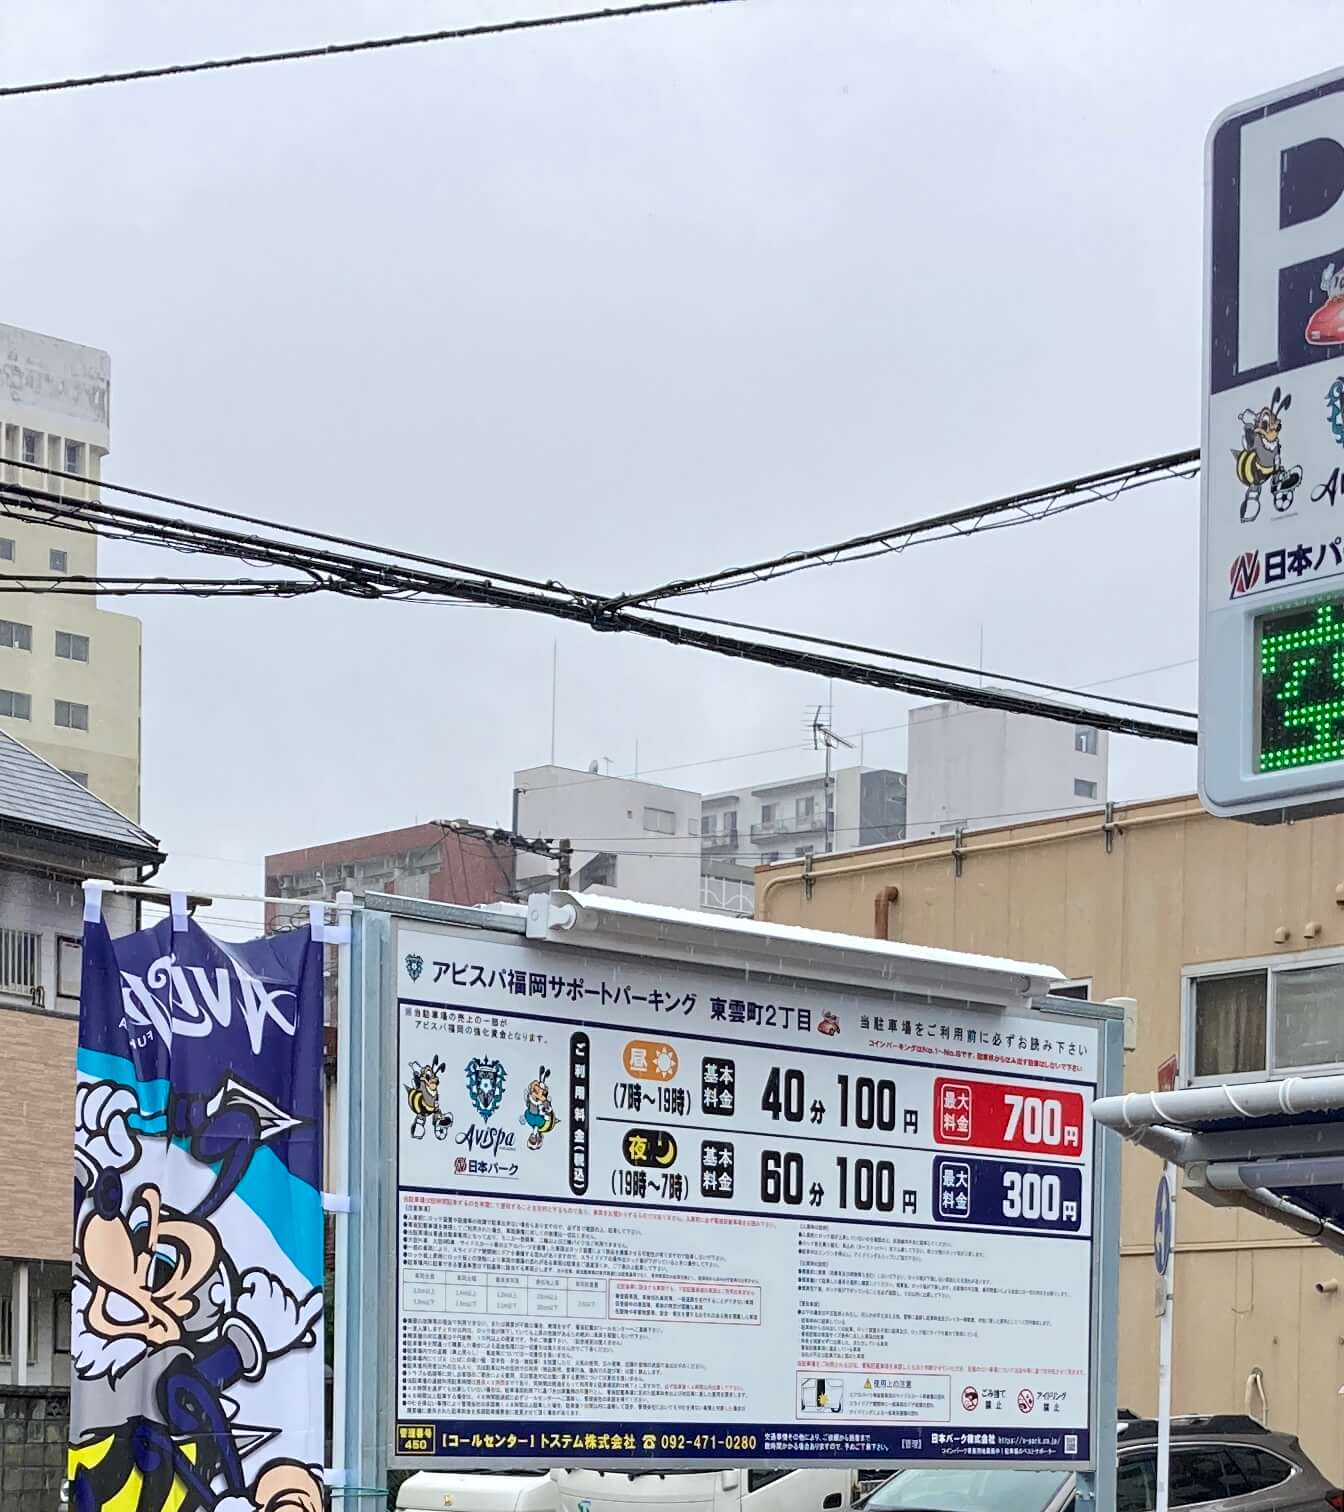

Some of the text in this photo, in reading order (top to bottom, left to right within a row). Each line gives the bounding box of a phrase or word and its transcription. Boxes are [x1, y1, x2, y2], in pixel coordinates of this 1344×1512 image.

[432, 960, 812, 1033] アビスパ福岡サポートパーキング 東雲町2丁目
[629, 1047, 648, 1073] 昼
[628, 1135, 647, 1161] 夜
[468, 1159, 520, 1176] 日本パーク
[540, 1433, 637, 1450] トステム株式会社
[660, 1433, 757, 1451] 092-471-0280
